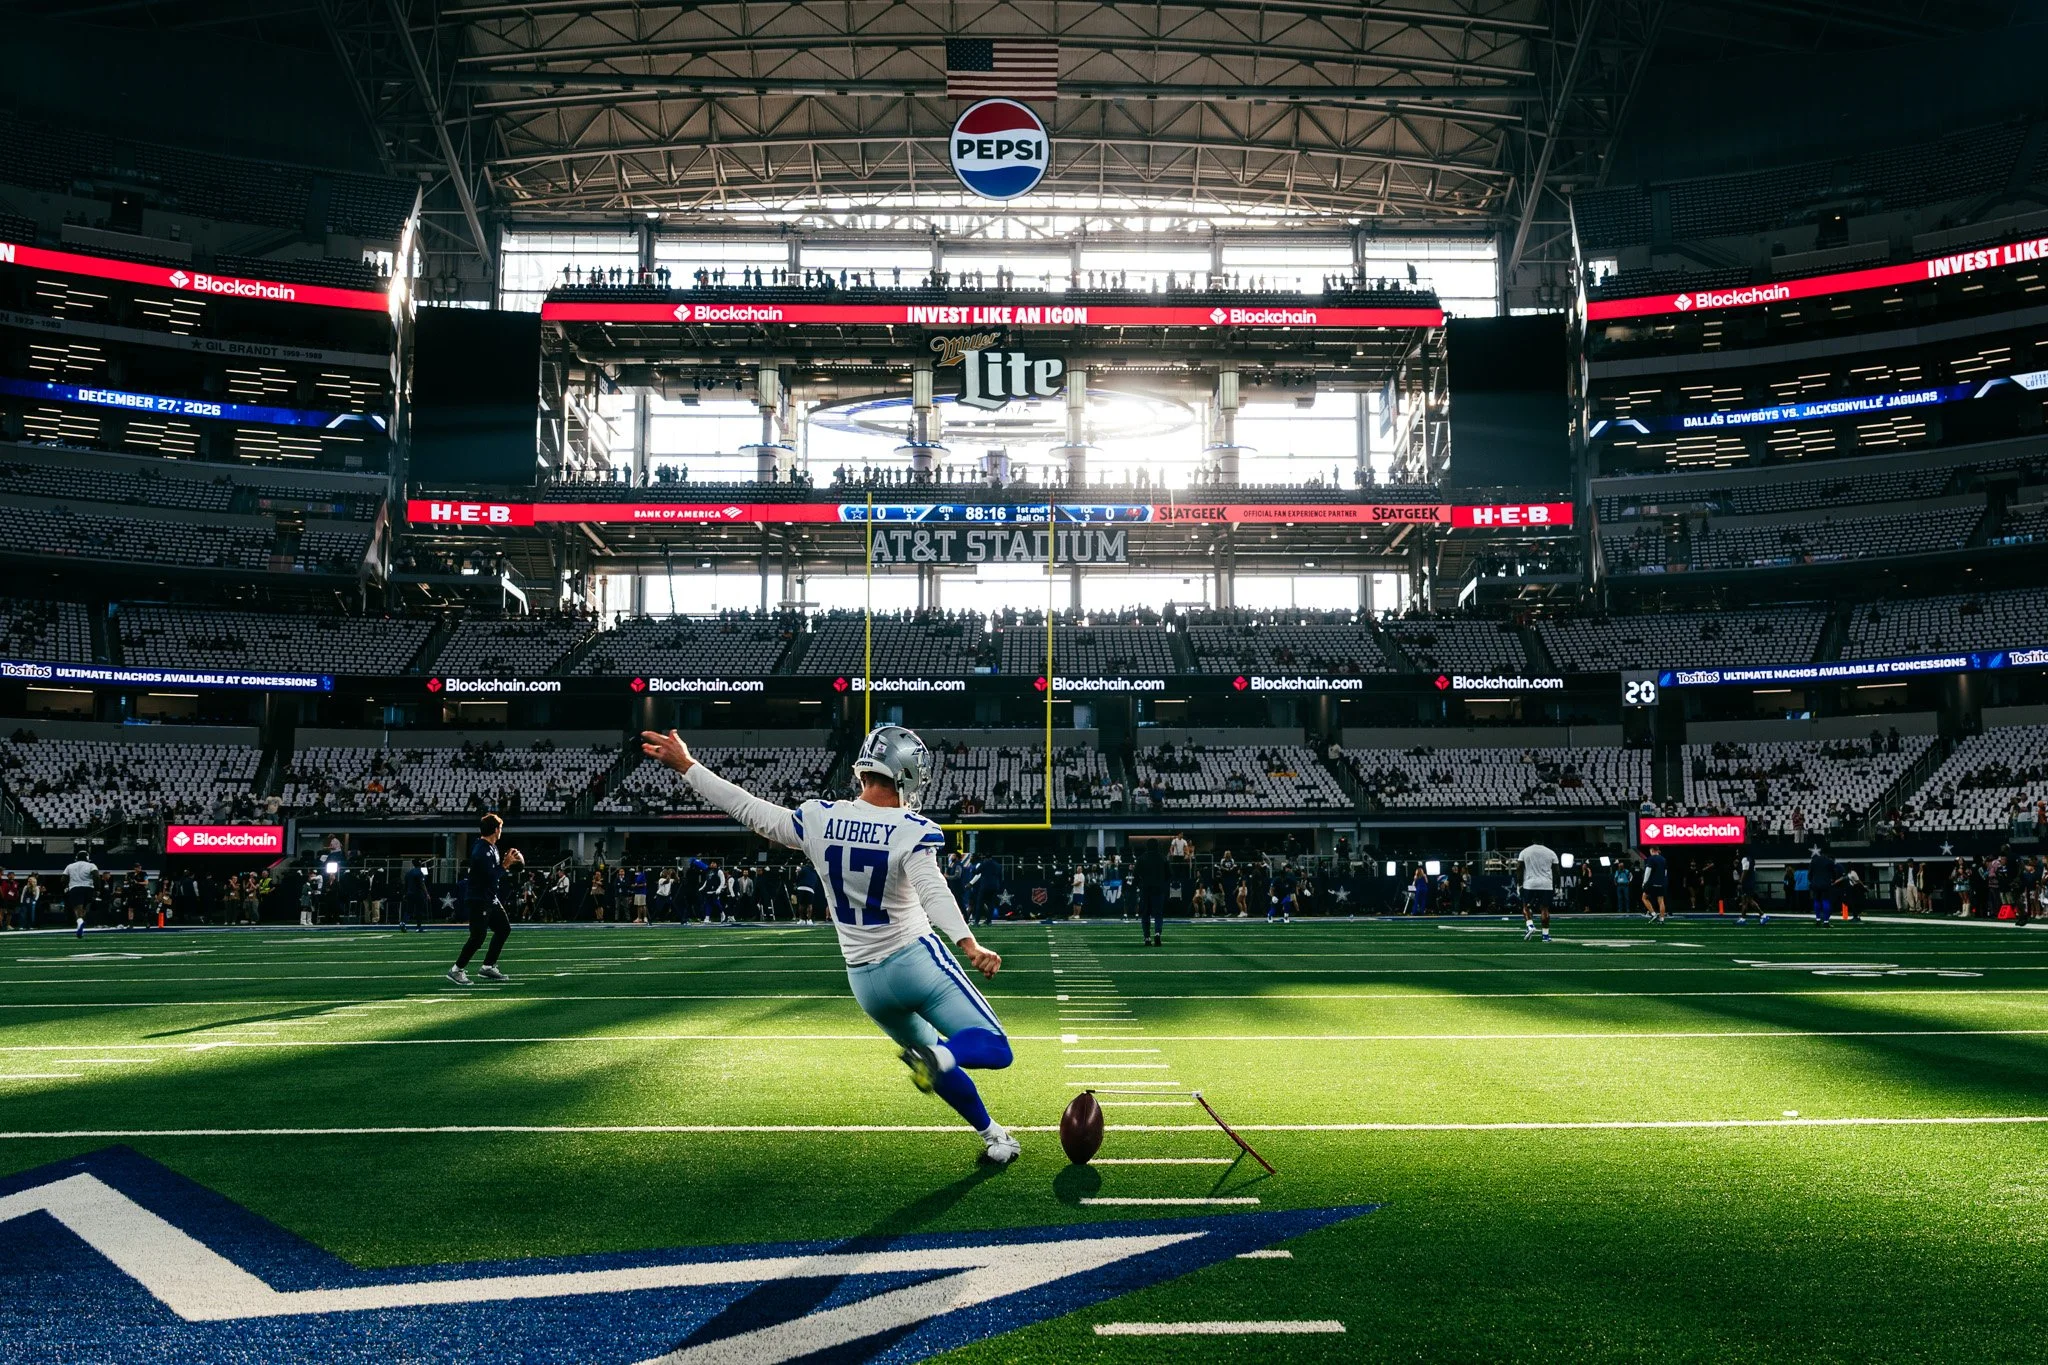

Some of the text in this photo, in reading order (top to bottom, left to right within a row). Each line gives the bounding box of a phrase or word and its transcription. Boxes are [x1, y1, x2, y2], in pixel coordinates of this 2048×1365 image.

[956, 139, 1043, 161] PEPSI
[1927, 238, 2048, 278] INVEST LIKE
[193, 274, 295, 300] Blockchain
[1695, 284, 1790, 308] Blockchain
[694, 305, 783, 321] Blockchain
[907, 306, 1088, 324] INVEST LIKE AN ICON
[1230, 309, 1317, 324] Blockchain
[206, 341, 225, 352] GIL
[229, 343, 278, 357] BRANDT
[930, 331, 1001, 364] Miller
[959, 350, 1063, 410] Lite
[78, 389, 221, 416] DECEMBER 27, 2026
[1683, 391, 1938, 427] DALLAS COWBOYS VS. JACKSONVILLE JAGUARS
[634, 510, 721, 518] BANK OF AMERICA
[876, 506, 887, 519] 0
[965, 507, 1007, 520] 88:16
[1016, 514, 1031, 522] Ball
[1033, 514, 1044, 522] On
[1105, 507, 1115, 520] 0
[1159, 507, 1227, 520] SEATGEEK
[1372, 507, 1440, 520] SEATGEEK
[871, 530, 1127, 562] AT&T STADIUM
[1, 662, 318, 687] Tostitos ULTIMATE NACHOS AVAILABLE AT CONCESSIONS
[1677, 657, 1967, 684] Tostitos ULTIMATE NACHOS AVAILABLE AT CONCESSIONS
[445, 678, 561, 692] Blockchain.com
[649, 678, 764, 691] Blockchain.com
[851, 677, 966, 691] Blockchain.com
[1052, 677, 1165, 691] Blockchain.com
[1250, 676, 1363, 690] Blockchain.com
[1452, 675, 1564, 689] Blockchain.com
[1625, 680, 1656, 704] 20
[823, 818, 897, 846] AUBREY
[1662, 823, 1740, 837] Blockchain
[193, 832, 277, 846] Blockchain
[824, 844, 890, 926] 17
